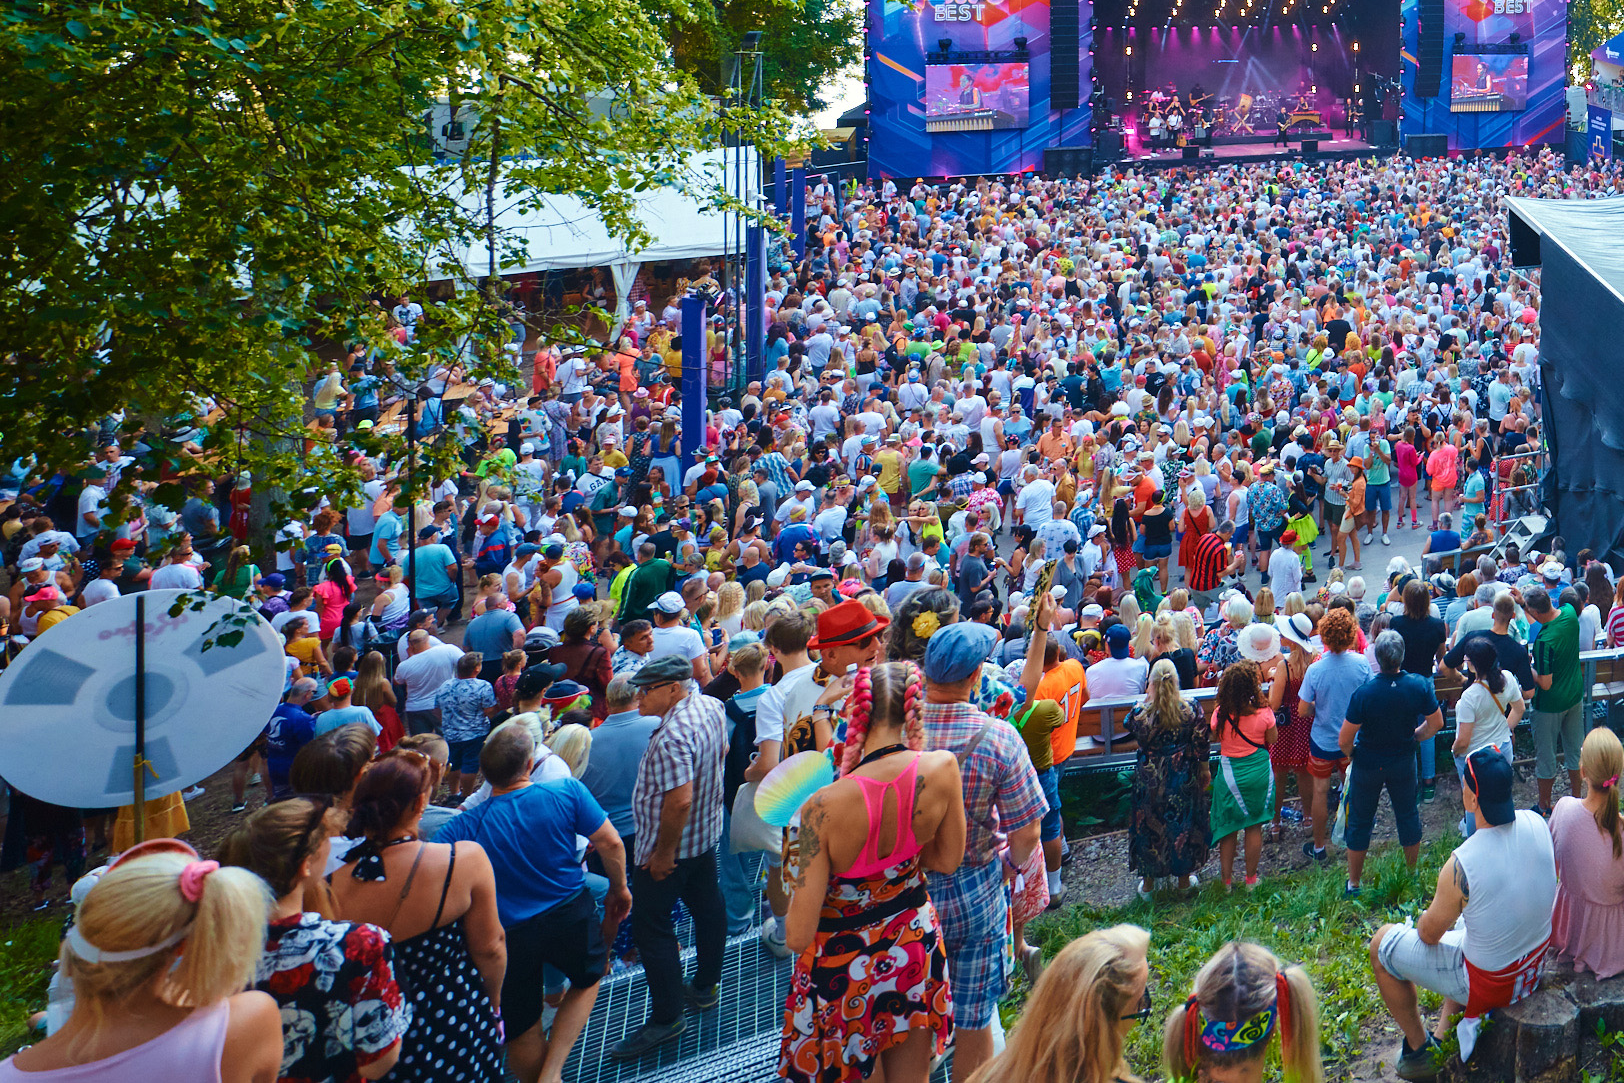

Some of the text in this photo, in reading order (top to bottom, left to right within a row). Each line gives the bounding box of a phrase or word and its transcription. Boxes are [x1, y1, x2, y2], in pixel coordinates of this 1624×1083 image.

[934, 4, 985, 21] BEST
[1494, 0, 1533, 14] BEST
[1059, 681, 1081, 724] 17
